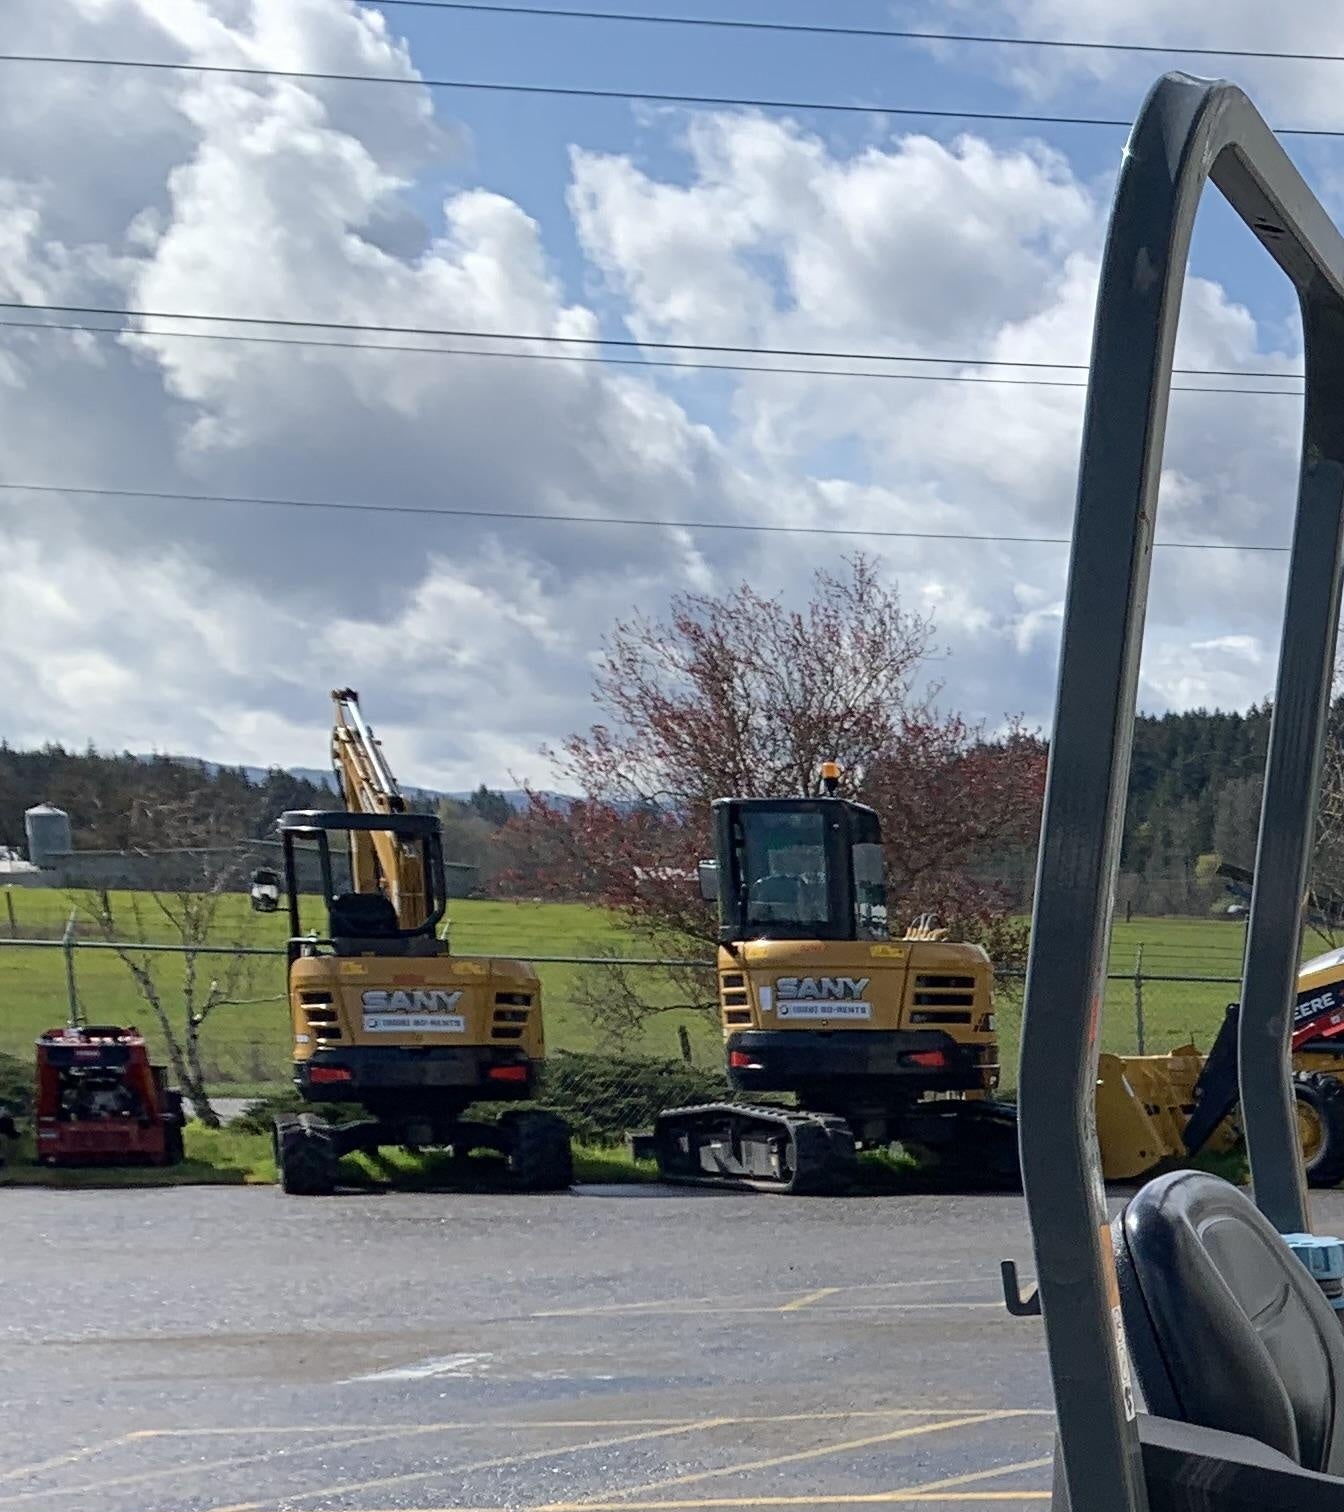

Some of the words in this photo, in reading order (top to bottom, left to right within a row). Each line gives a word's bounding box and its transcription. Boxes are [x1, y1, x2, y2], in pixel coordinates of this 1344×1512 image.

[776, 977, 870, 1000] SANY
[361, 989, 464, 1013] SANY
[1294, 992, 1336, 1021] EERE
